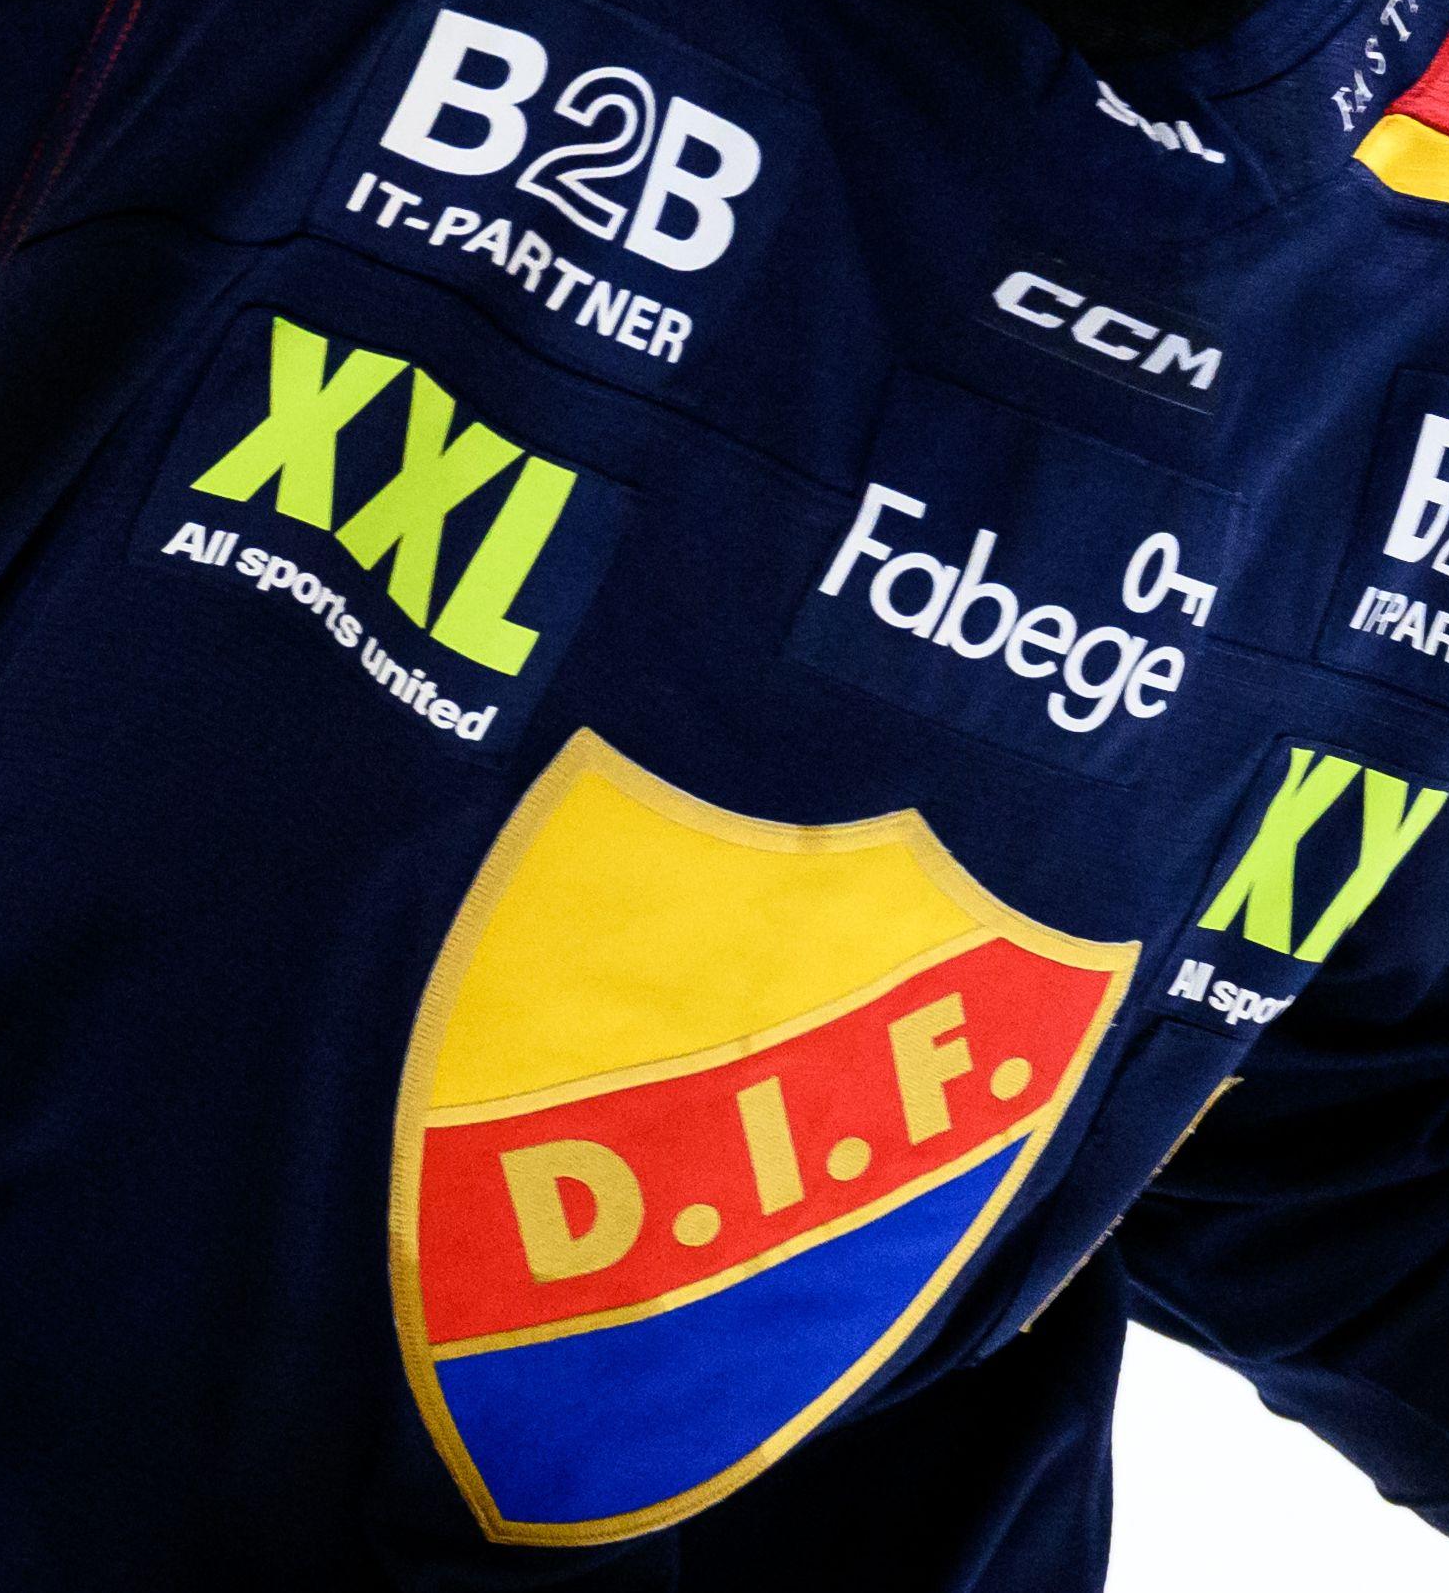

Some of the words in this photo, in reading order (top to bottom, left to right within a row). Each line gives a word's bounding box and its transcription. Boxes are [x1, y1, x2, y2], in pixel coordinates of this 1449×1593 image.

[380, 9, 762, 272] B2B
[346, 172, 694, 364] IT-PARTNER
[992, 271, 1223, 391] CCM
[190, 317, 578, 677] XXL
[818, 483, 1186, 733] Fabege
[162, 522, 237, 567] All
[235, 548, 362, 650] sports
[361, 640, 498, 743] united
[500, 992, 1033, 1284] D.I.F.
